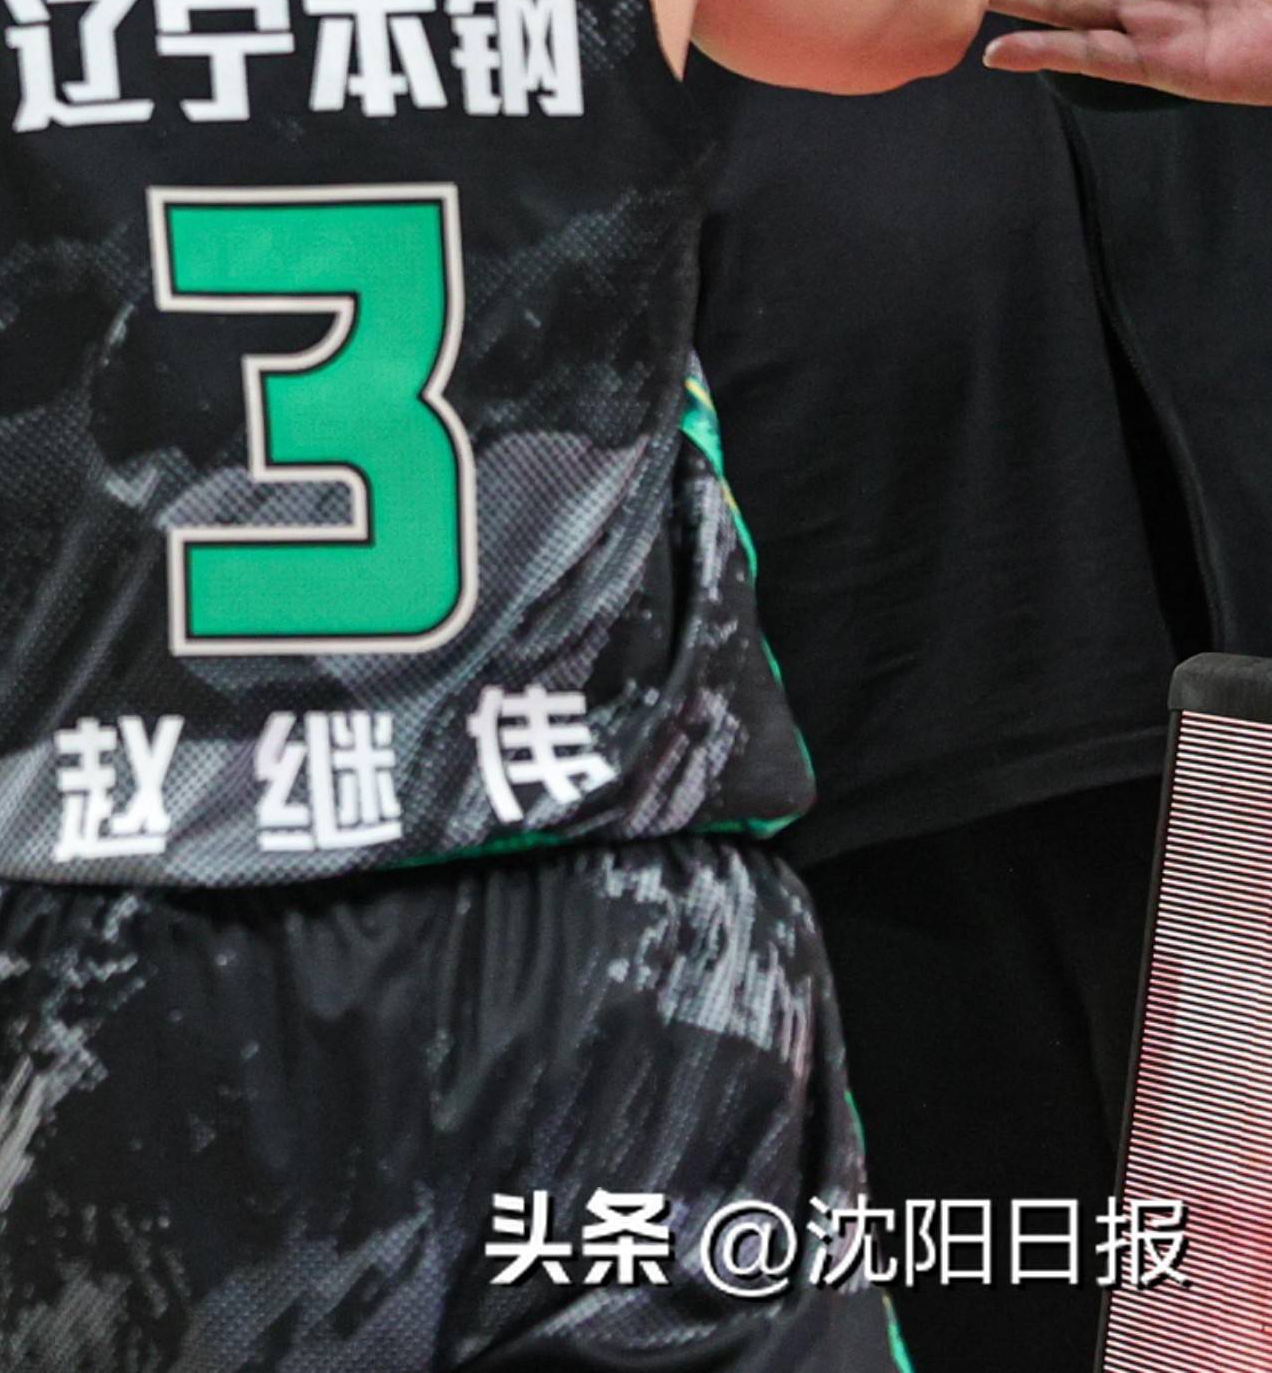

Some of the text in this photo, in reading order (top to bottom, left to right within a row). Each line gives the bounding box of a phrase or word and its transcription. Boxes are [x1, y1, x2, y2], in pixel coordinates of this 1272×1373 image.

[146, 182, 477, 657] 3
[54, 684, 618, 862] 赵继伟
